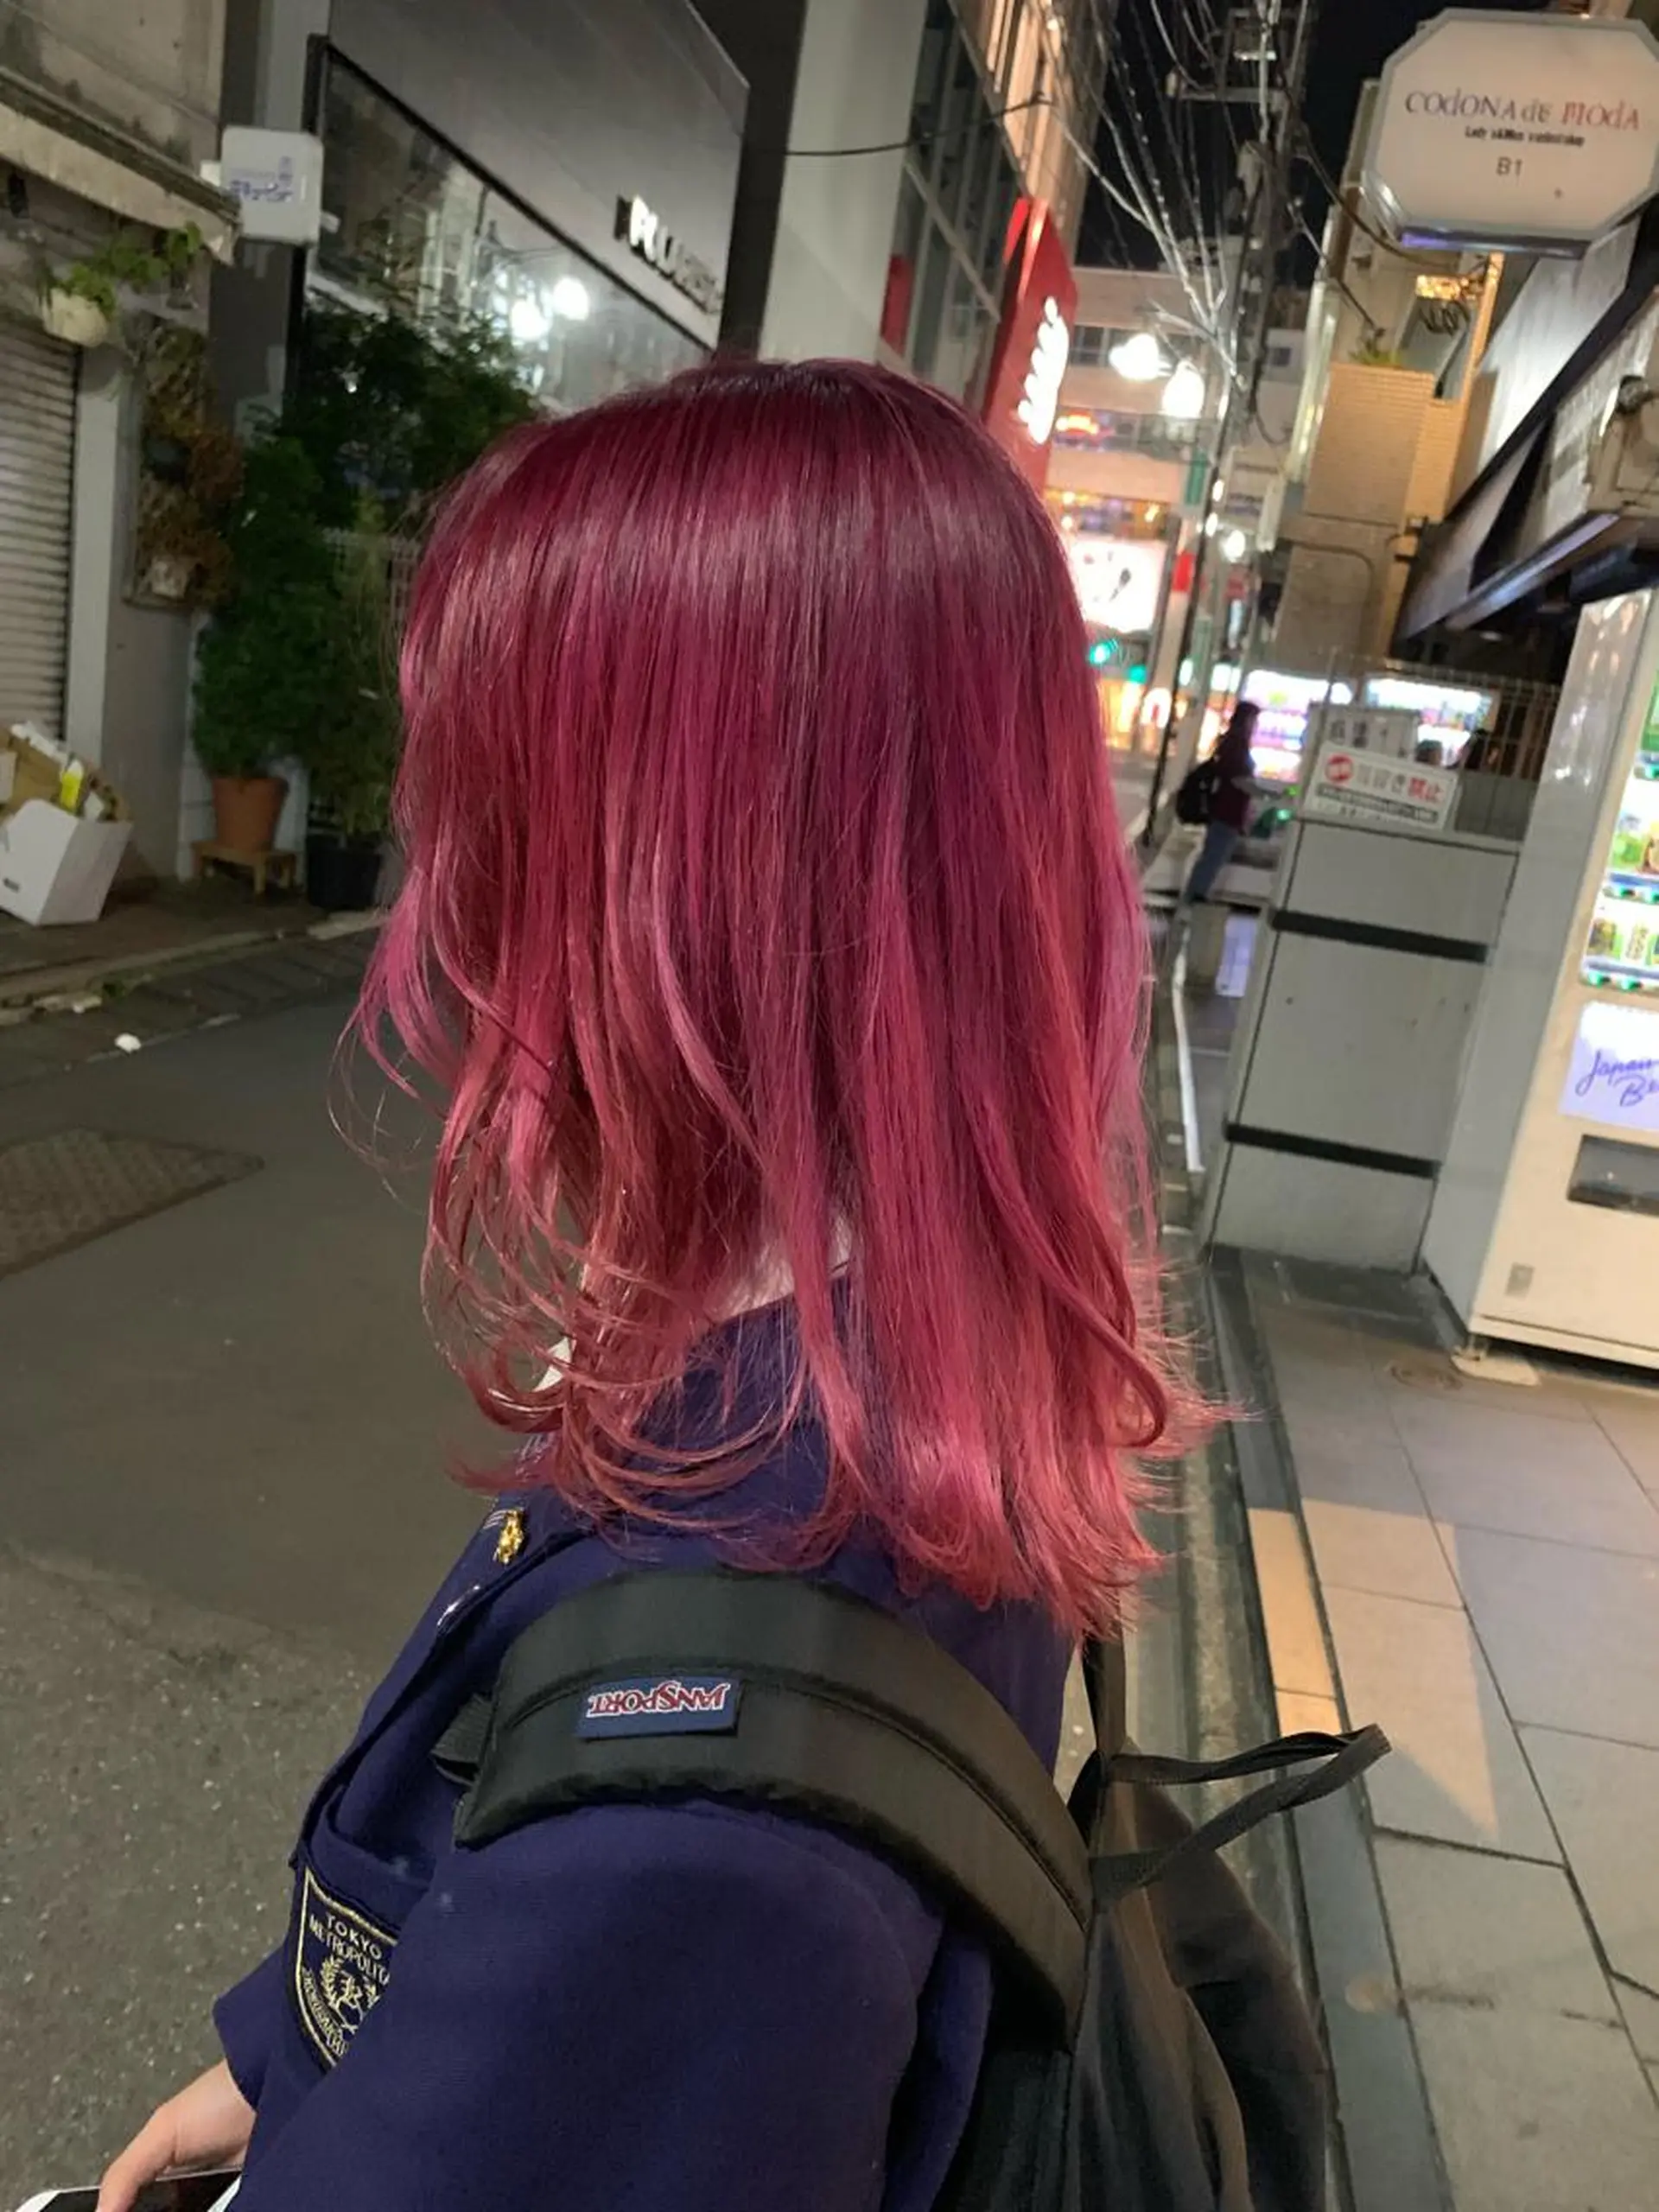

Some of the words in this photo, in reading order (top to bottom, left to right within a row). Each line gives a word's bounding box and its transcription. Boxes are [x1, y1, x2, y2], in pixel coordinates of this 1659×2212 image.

[1496, 156, 1522, 176] B1
[586, 1680, 731, 1718] JANSPORT
[325, 1910, 382, 1960] TOKYO
